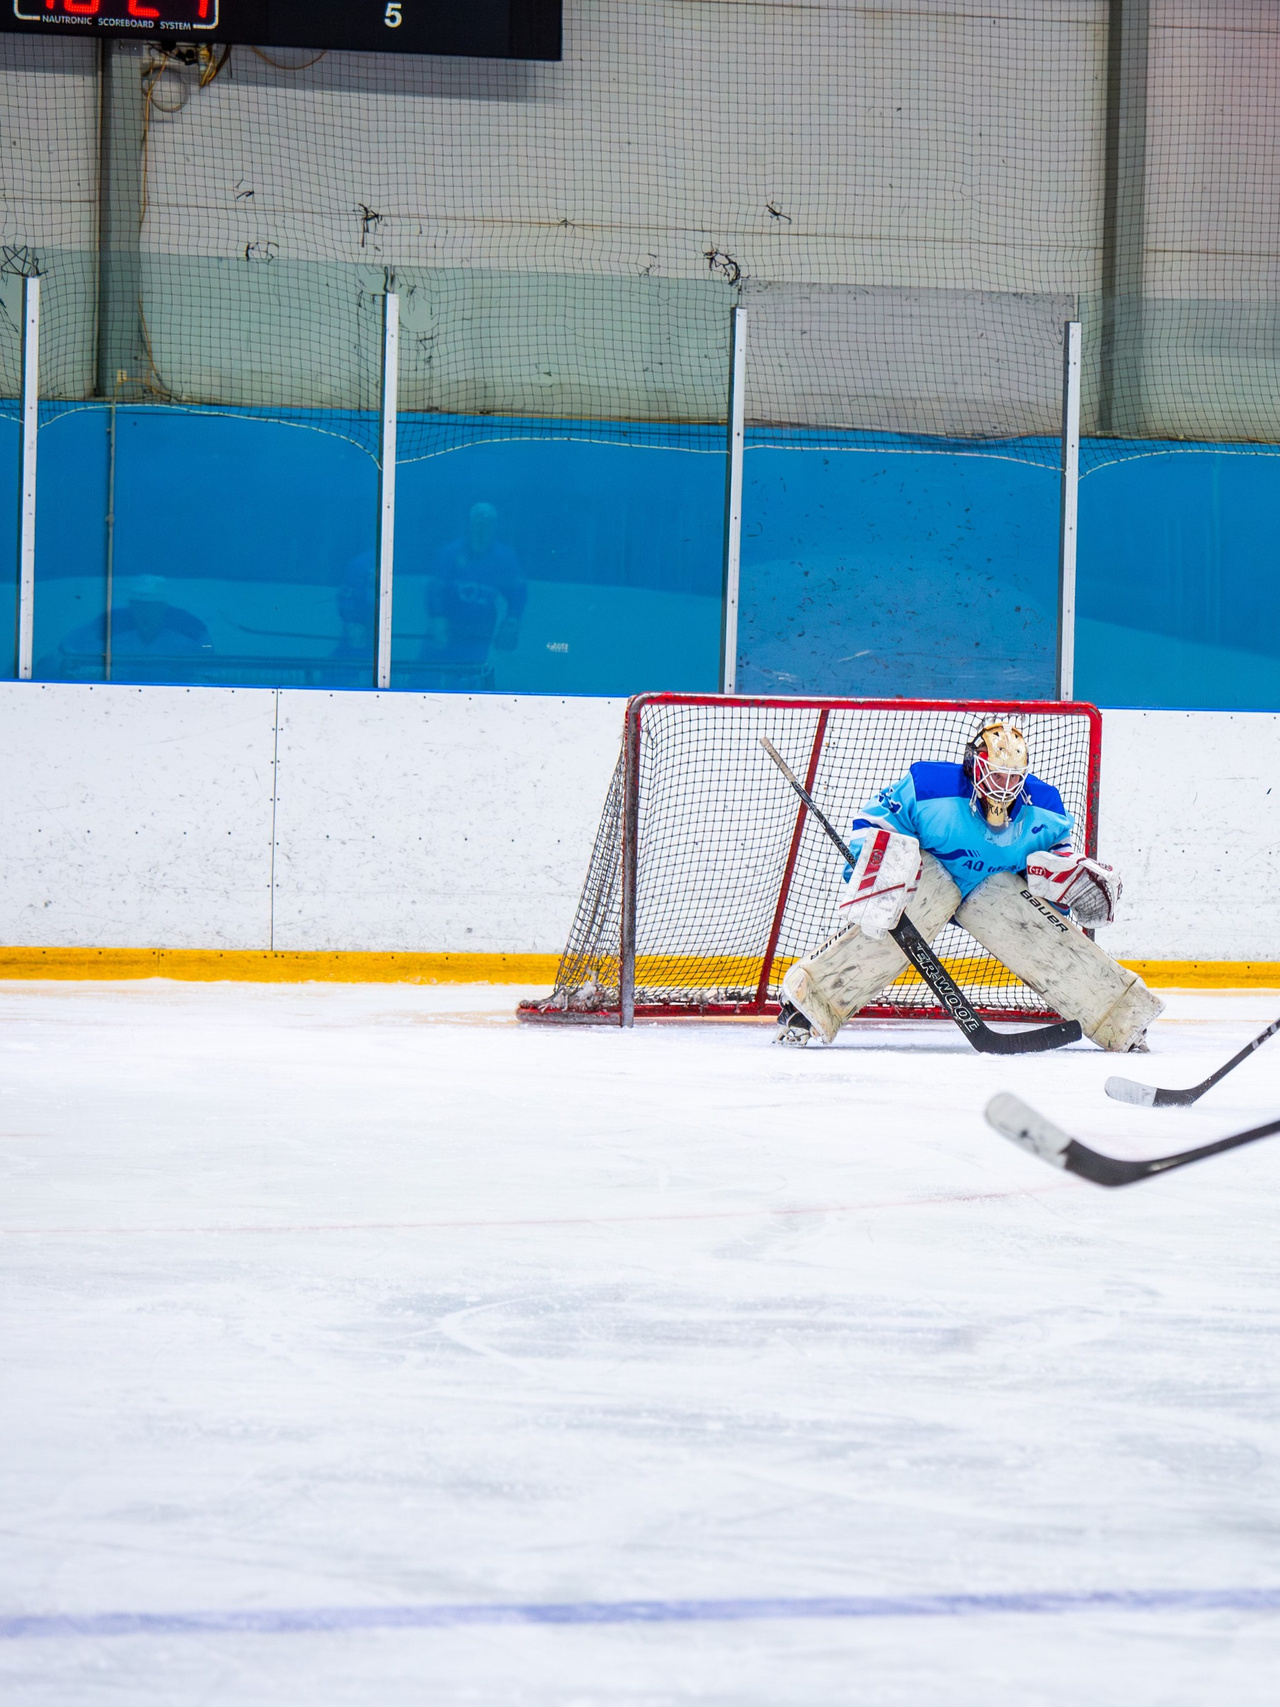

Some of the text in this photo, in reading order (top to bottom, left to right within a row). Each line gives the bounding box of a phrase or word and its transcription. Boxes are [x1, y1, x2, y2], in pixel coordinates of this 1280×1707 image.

[42, 14, 192, 31] NAUTRONIC SCOREBOARD SYSTEM
[383, 2, 403, 28] 5
[1020, 889, 1069, 933] BAUER
